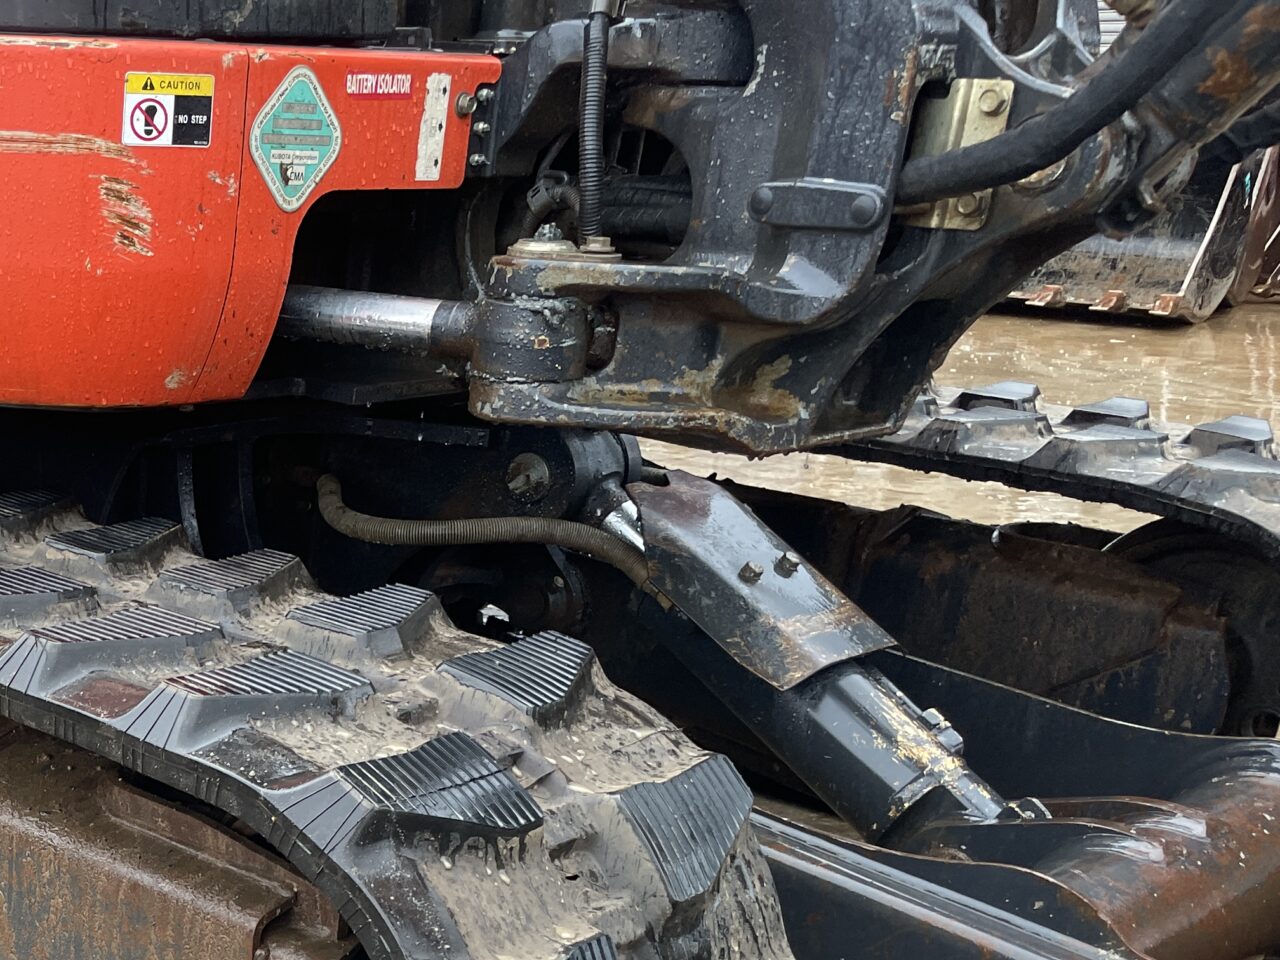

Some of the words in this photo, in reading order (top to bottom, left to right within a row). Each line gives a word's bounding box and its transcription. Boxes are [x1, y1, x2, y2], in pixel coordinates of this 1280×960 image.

[159, 80, 201, 91] CAUTION
[346, 74, 377, 94] BATTERY
[377, 74, 412, 94] ISOLATOR
[178, 114, 188, 124] NO
[191, 114, 208, 124] STEP
